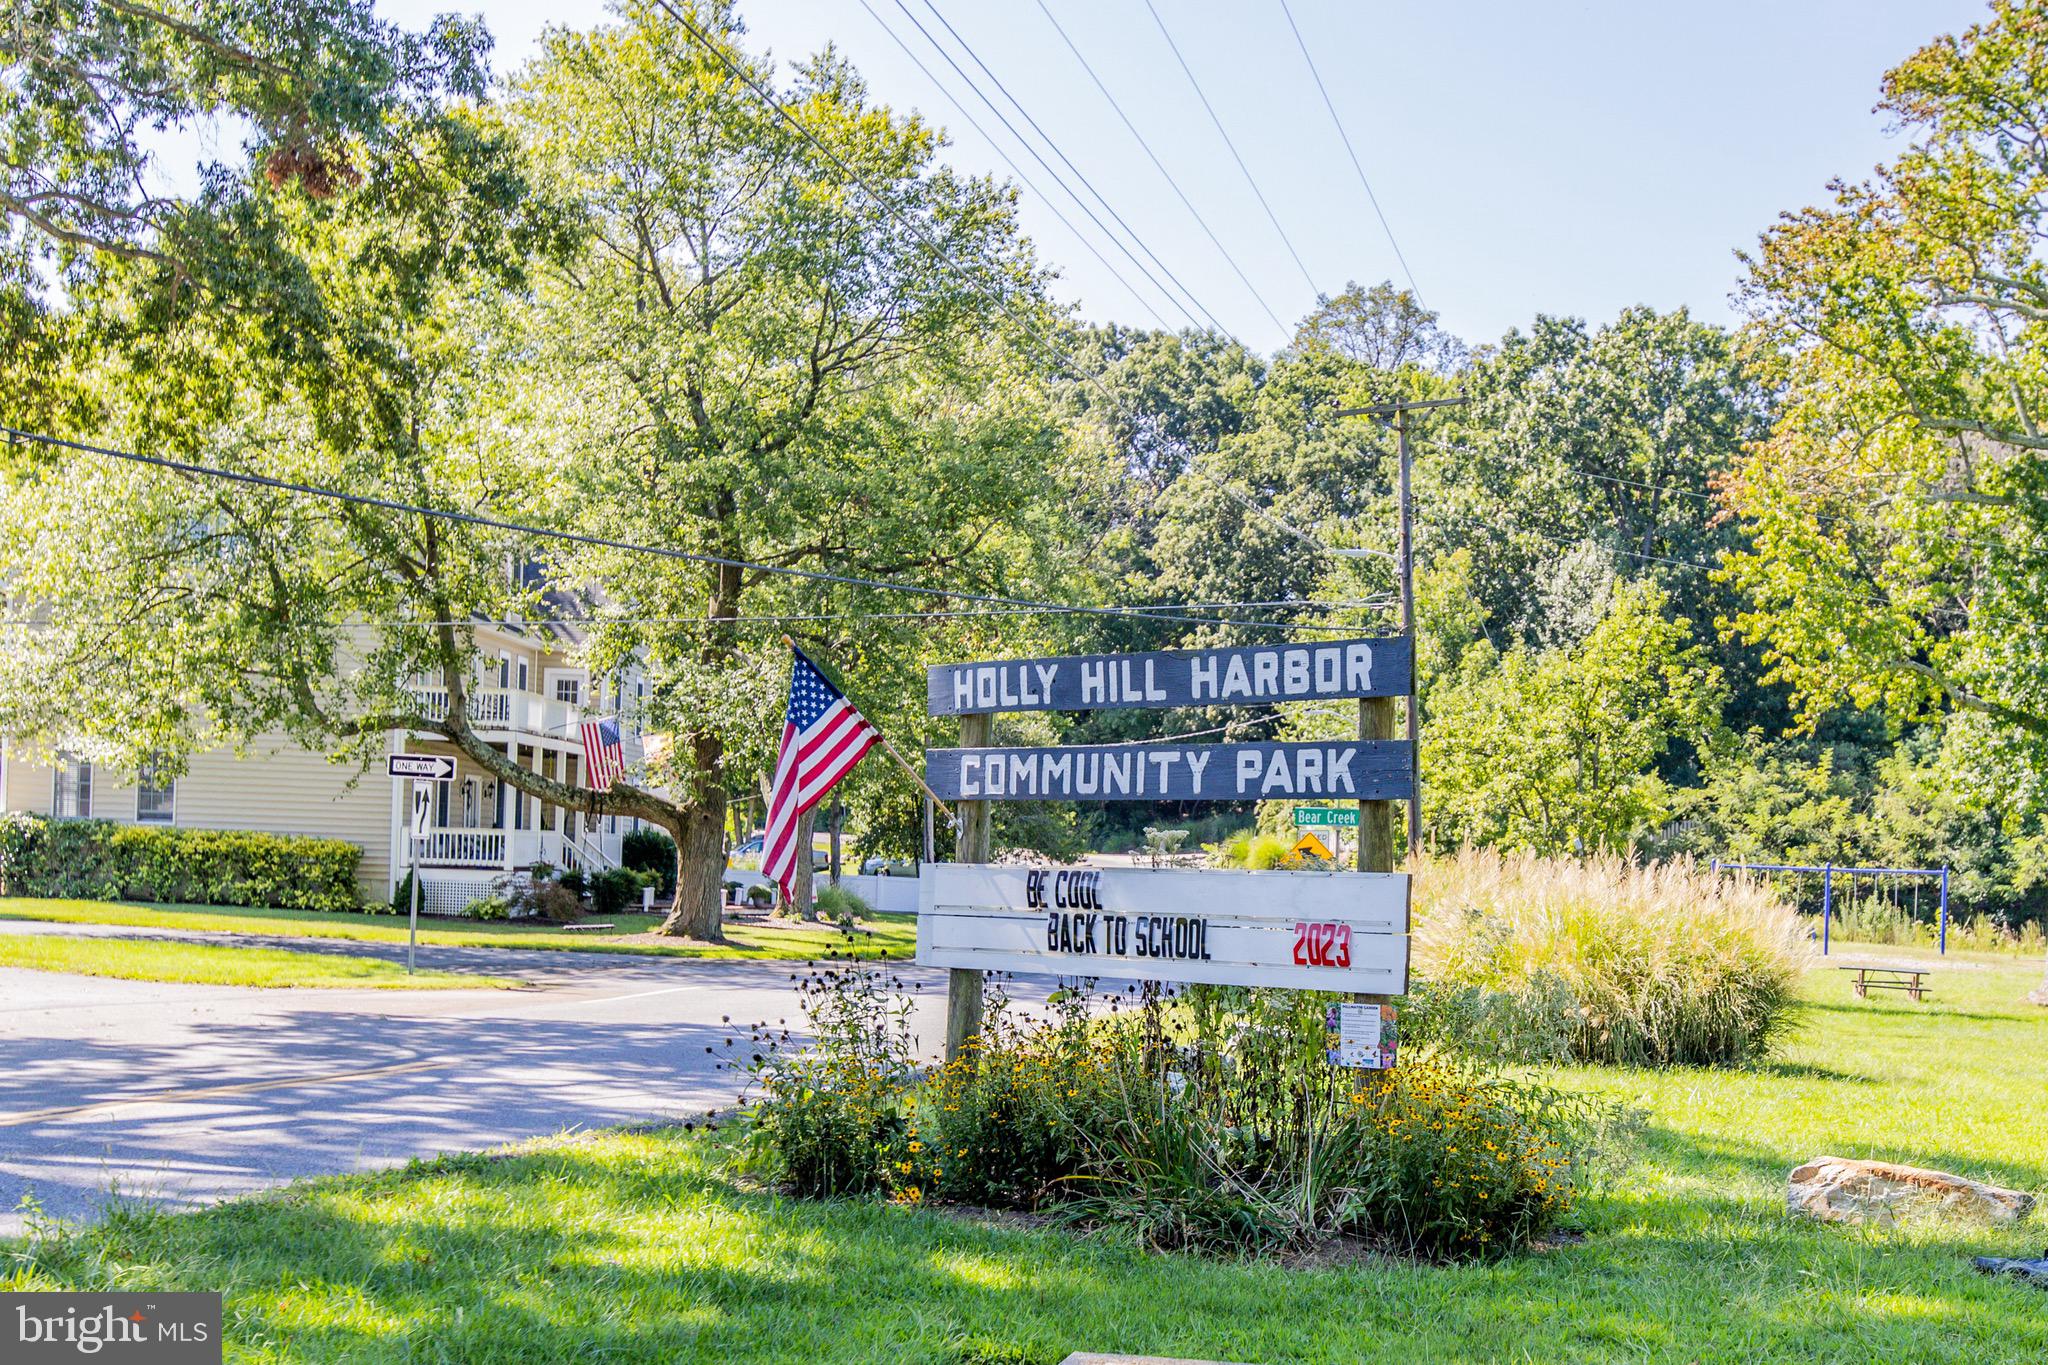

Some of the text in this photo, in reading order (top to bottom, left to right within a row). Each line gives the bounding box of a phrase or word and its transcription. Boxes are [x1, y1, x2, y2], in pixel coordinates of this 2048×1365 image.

[954, 643, 1373, 709] HOLLY HILL HARBOR
[395, 762, 434, 771] ONE WAY
[959, 748, 1357, 795] COMMUNITY PARK
[1298, 810, 1356, 824] Bear Creek
[1026, 870, 1103, 910] BE COOL
[1047, 913, 1351, 967] BACK TO SCHOOL 2023
